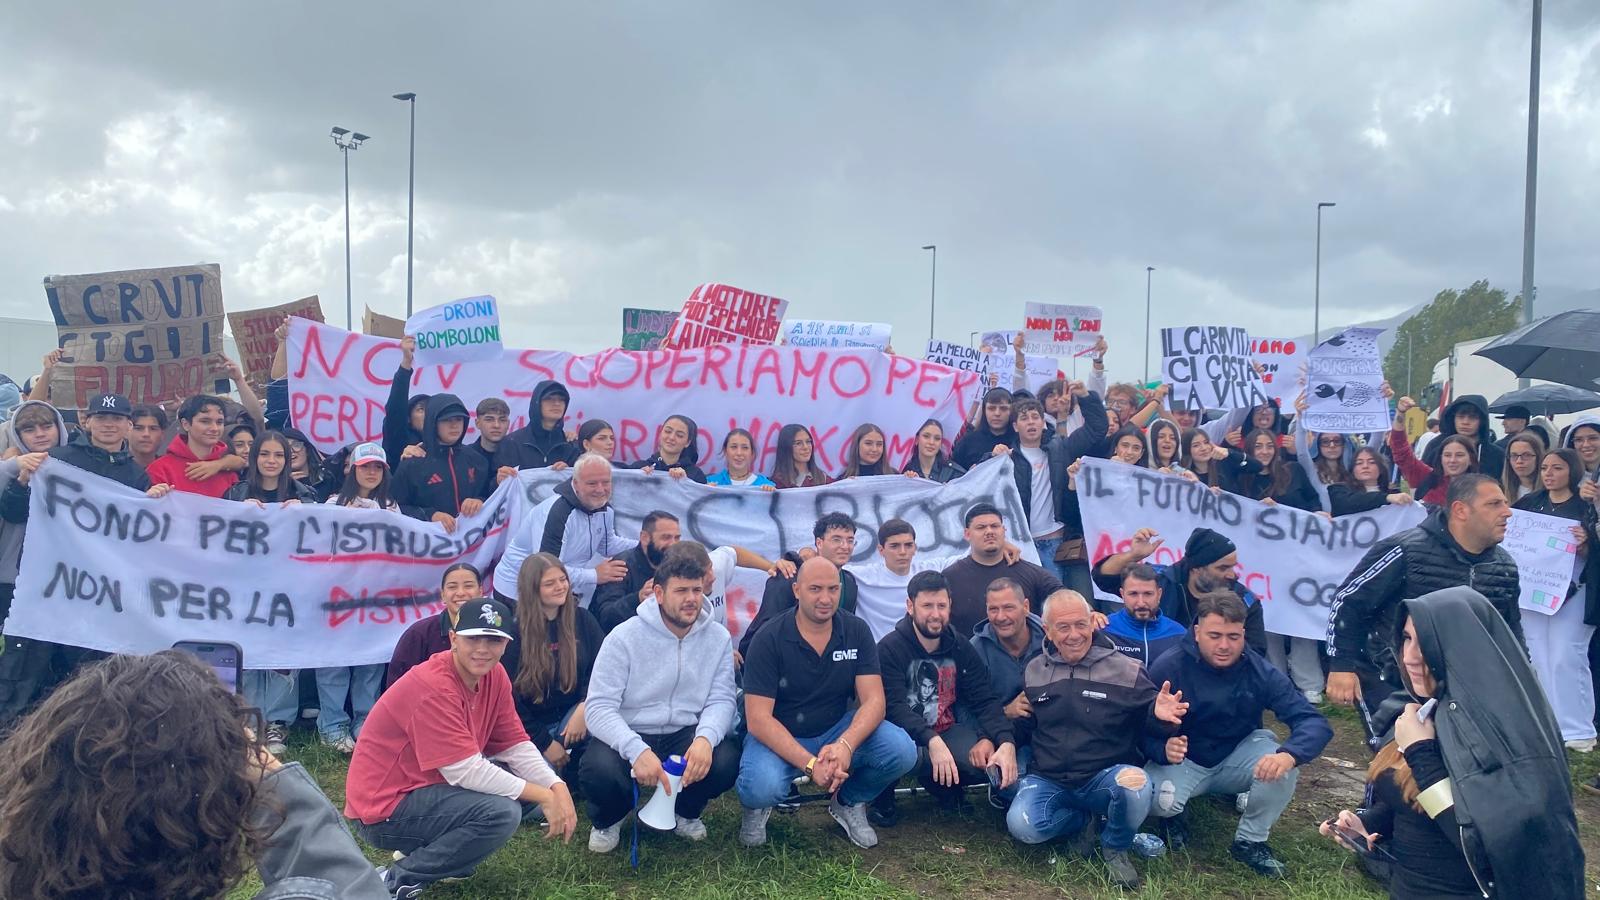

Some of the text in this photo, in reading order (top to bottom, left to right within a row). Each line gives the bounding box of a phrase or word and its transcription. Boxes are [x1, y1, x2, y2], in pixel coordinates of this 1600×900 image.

[929, 341, 990, 365] LA MELONI A
[1161, 326, 1252, 357] IL CAROVITA
[1251, 339, 1297, 356] IAMO
[74, 358, 204, 408] FUTURO
[975, 363, 987, 375] LA
[1168, 360, 1199, 383] CI
[1206, 355, 1260, 382] COSTA
[1168, 383, 1202, 411] LA
[1211, 379, 1269, 408] VITA
[43, 474, 171, 543] FONDI
[199, 514, 270, 557] PER
[1085, 465, 1381, 550] IL FUTURO SIAMO
[44, 561, 124, 614] NON
[148, 577, 234, 622] PER
[244, 590, 295, 628] LA
[832, 648, 859, 662] GME
